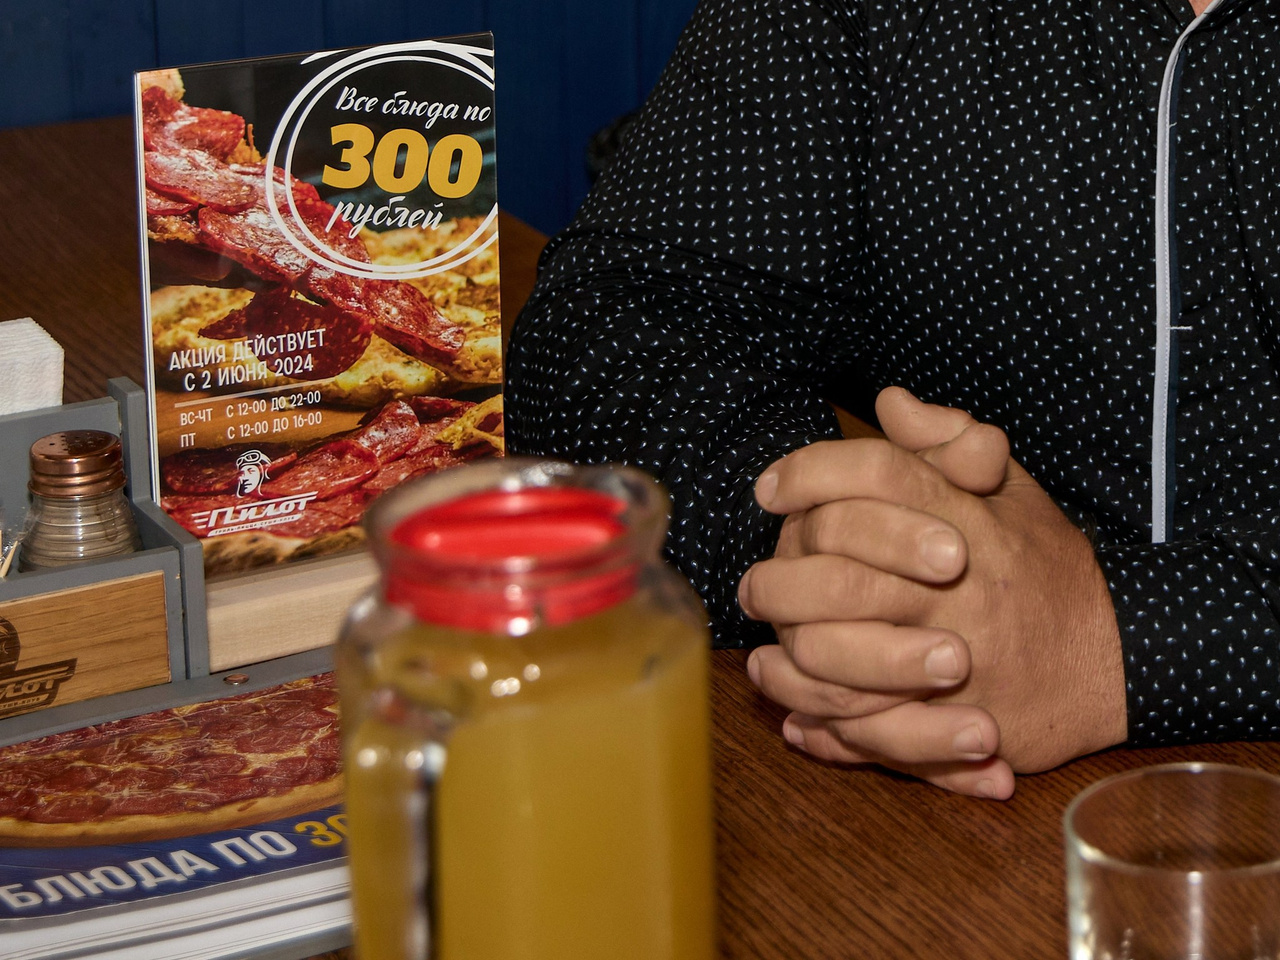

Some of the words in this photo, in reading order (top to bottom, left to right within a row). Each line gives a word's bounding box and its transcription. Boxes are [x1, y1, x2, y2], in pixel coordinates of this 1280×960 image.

[335, 85, 379, 113] Все
[382, 90, 461, 130] блюда
[463, 105, 492, 122] по
[321, 123, 483, 199] 300
[324, 195, 444, 240] рублей
[168, 343, 227, 372] АКЦИЯ
[232, 327, 327, 363] ДЕЙСТВУЕТ
[184, 372, 196, 392] С
[201, 370, 212, 389] 2
[218, 360, 267, 387] ИЮНЯ
[274, 353, 314, 377] 2024
[180, 408, 214, 426] ВС-ЧТ
[226, 404, 235, 418] С
[237, 399, 267, 416] 12-00
[271, 395, 286, 412] ДО
[290, 390, 321, 407] 22-00
[180, 432, 196, 448] ПТ
[227, 426, 236, 439] С
[239, 420, 269, 438] 12-00
[272, 416, 289, 433] ДО
[292, 411, 322, 428] 16-00
[0, 849, 221, 908] БЛЮДА
[211, 831, 298, 866] ПО
